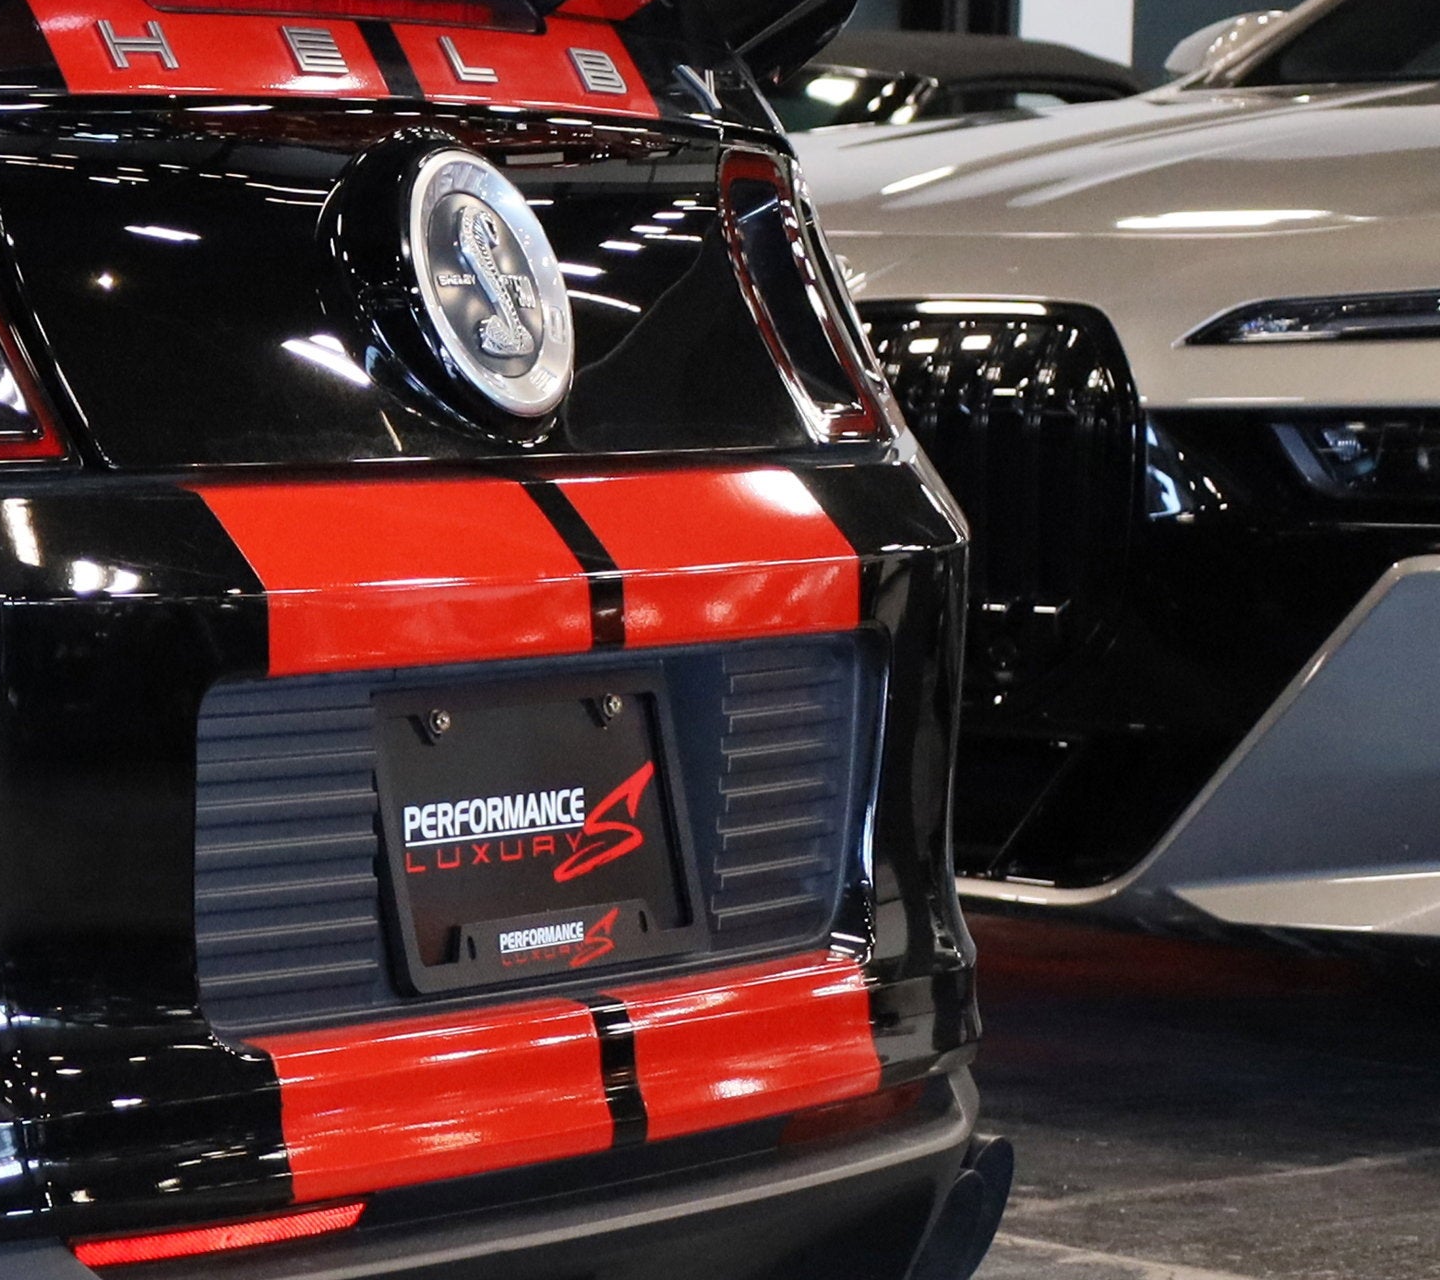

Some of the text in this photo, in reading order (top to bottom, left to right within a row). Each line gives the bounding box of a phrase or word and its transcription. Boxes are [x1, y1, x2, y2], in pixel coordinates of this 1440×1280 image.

[404, 787, 585, 841] PERFORMANCE
[406, 833, 581, 873] LUXURY
[500, 921, 584, 951] PERFORMANCE
